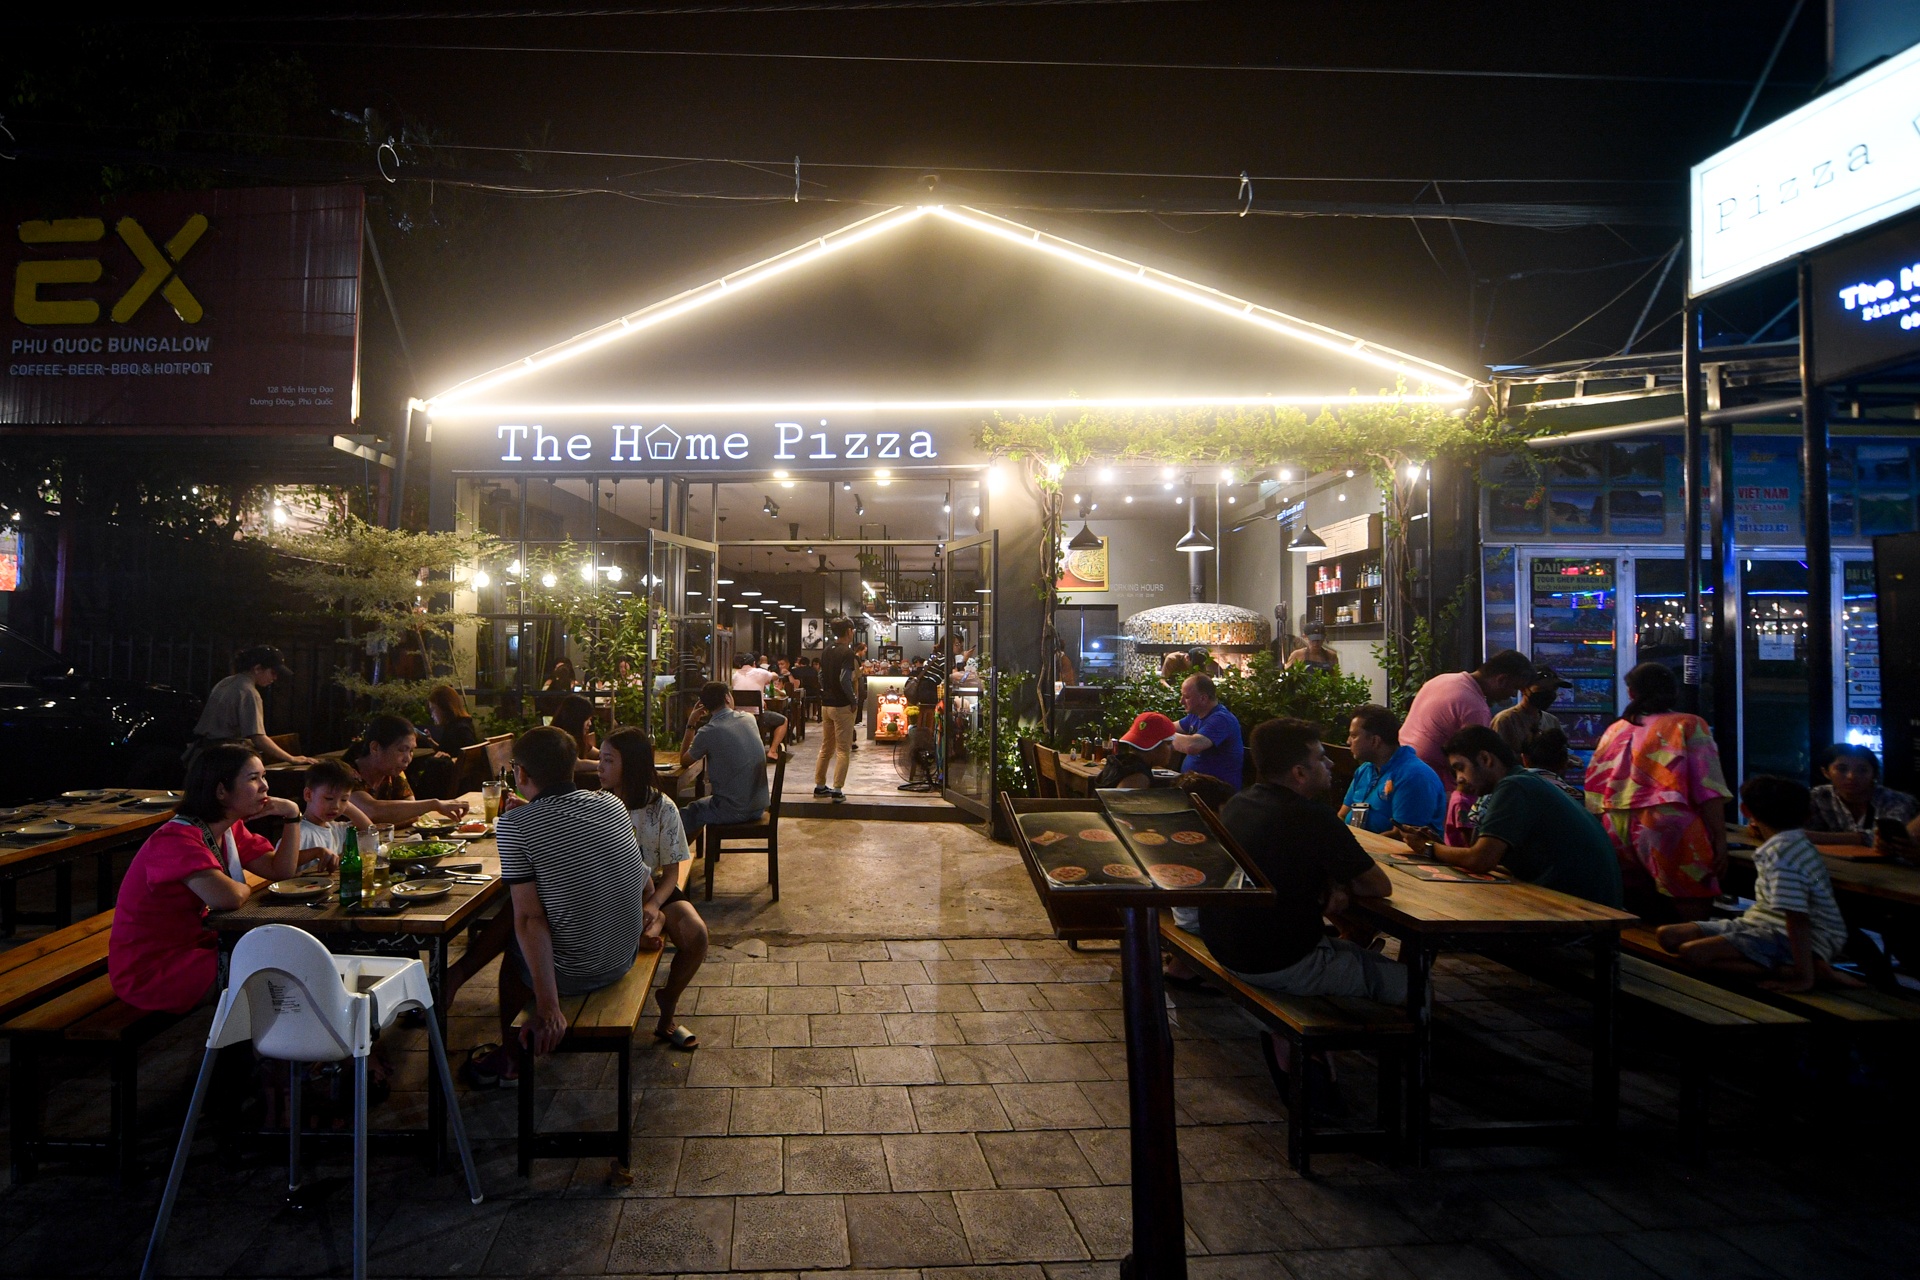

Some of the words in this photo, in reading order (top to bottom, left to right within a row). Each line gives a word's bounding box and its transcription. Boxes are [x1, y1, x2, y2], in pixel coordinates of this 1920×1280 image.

[1715, 143, 1875, 234] Pizza
[13, 213, 209, 325] EX
[1838, 279, 1895, 310] The
[11, 339, 47, 354] PHU
[53, 338, 103, 355] QUOC
[108, 337, 210, 353] BUNGALOW
[154, 362, 212, 375] HOTPOT
[498, 425, 592, 460] The
[773, 419, 937, 460] Pizza
[1763, 487, 1789, 499] NAM
[1140, 583, 1164, 592] HOURS
[1151, 622, 1173, 642] THE
[1177, 622, 1219, 643] HOME
[1221, 622, 1256, 642] PIZZA
